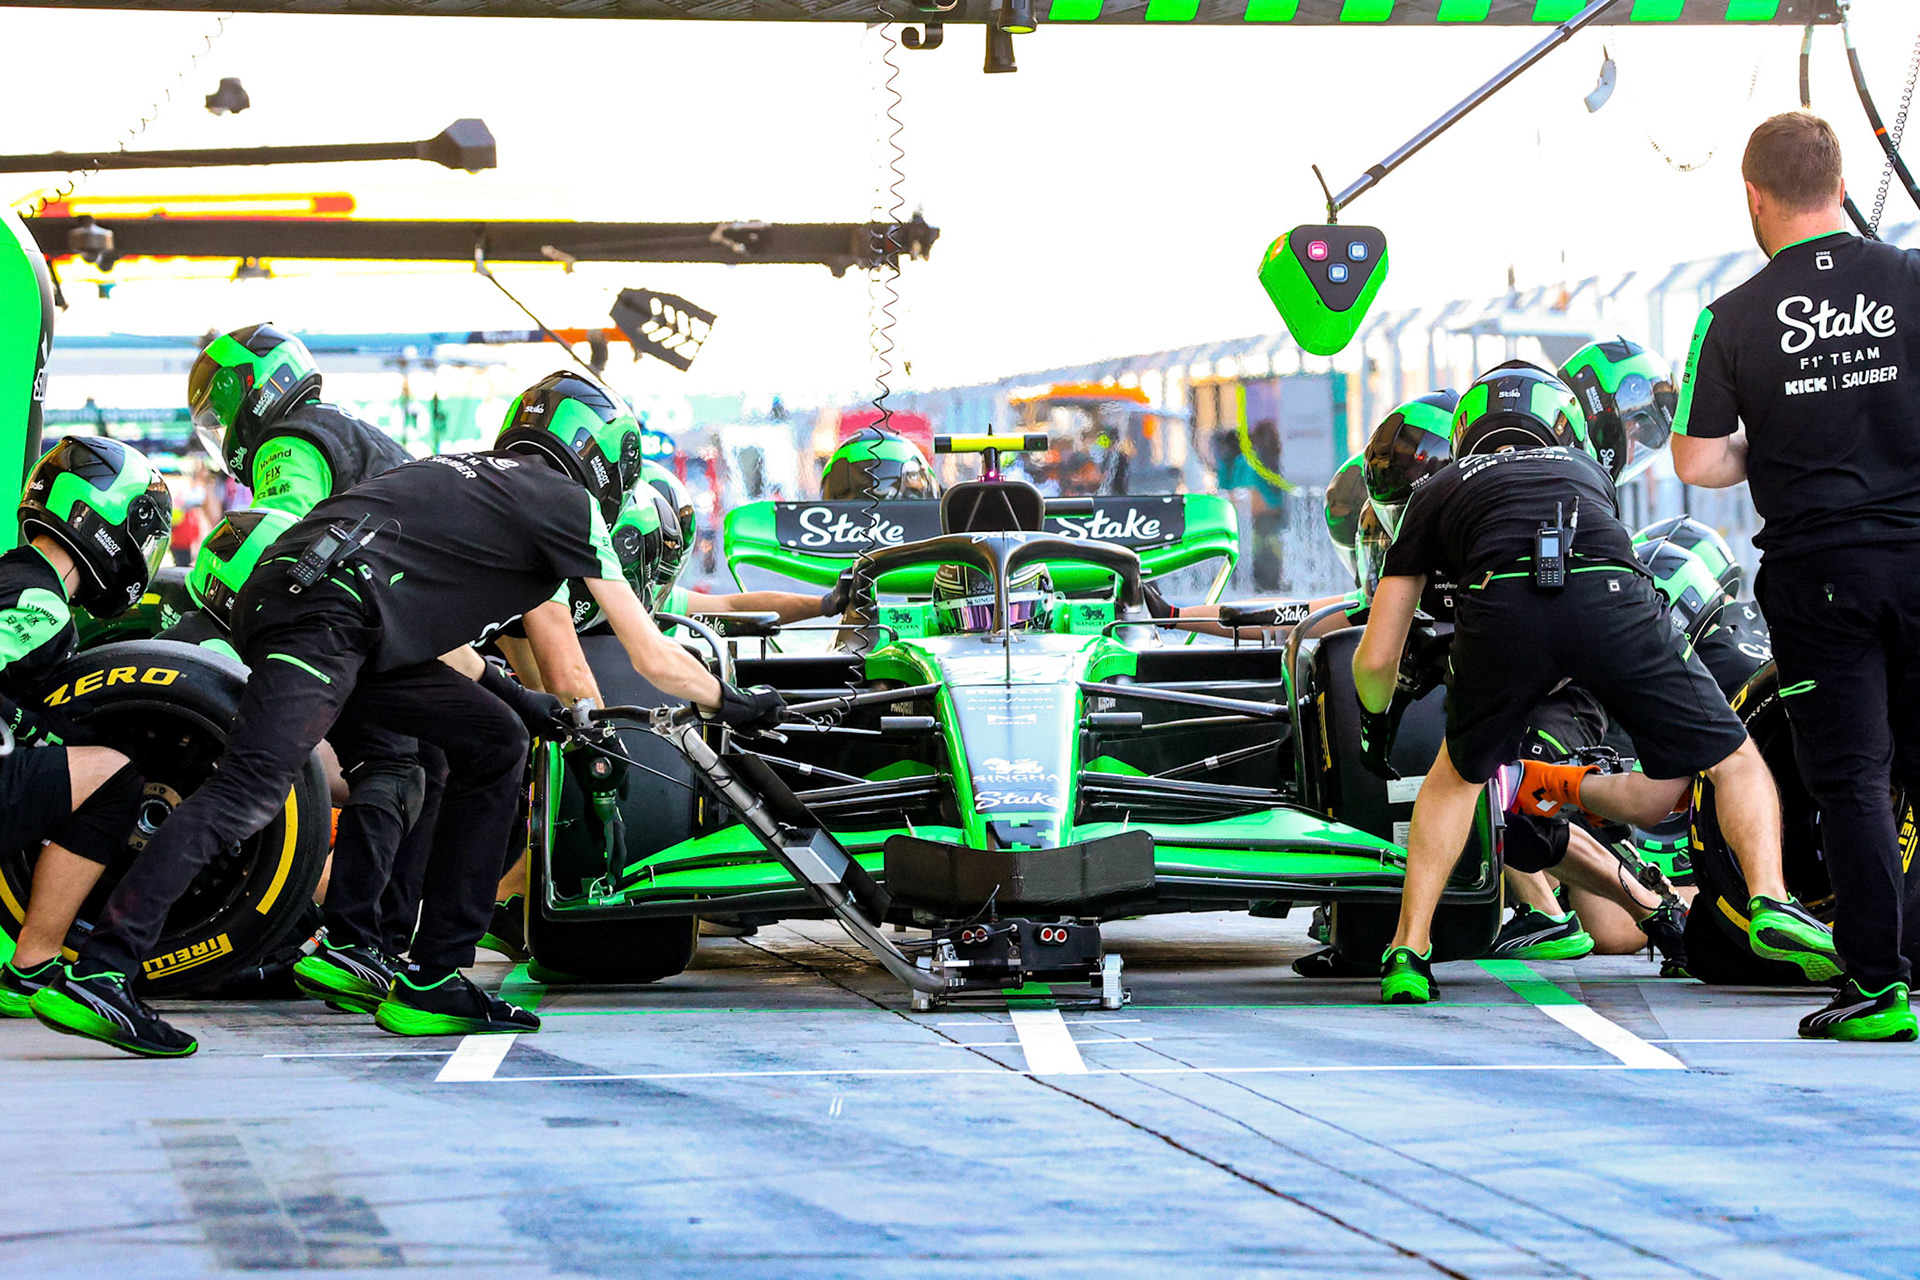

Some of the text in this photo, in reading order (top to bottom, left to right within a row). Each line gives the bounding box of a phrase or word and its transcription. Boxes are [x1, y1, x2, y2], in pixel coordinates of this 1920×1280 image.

[1776, 293, 1896, 354] Stake
[1830, 347, 1880, 365] TEAM
[1785, 366, 1898, 395] KICK SAUBER
[252, 389, 271, 415] MASCOT
[1589, 386, 1604, 412] MASCOT
[229, 446, 248, 471] Stake
[593, 455, 610, 484] MASCOT
[265, 464, 281, 481] FIX
[799, 506, 904, 546] Stake
[1057, 508, 1162, 541] Stake
[97, 527, 121, 552] MASCOT
[126, 582, 144, 605] Stake
[574, 599, 592, 625] Stake
[1273, 604, 1308, 625] Stake
[43, 666, 180, 707] ZERO
[14, 707, 23, 724] PIT
[972, 773, 1060, 783] SINGHA
[974, 790, 1061, 811] Stake
[142, 932, 234, 980] PIRELLI
